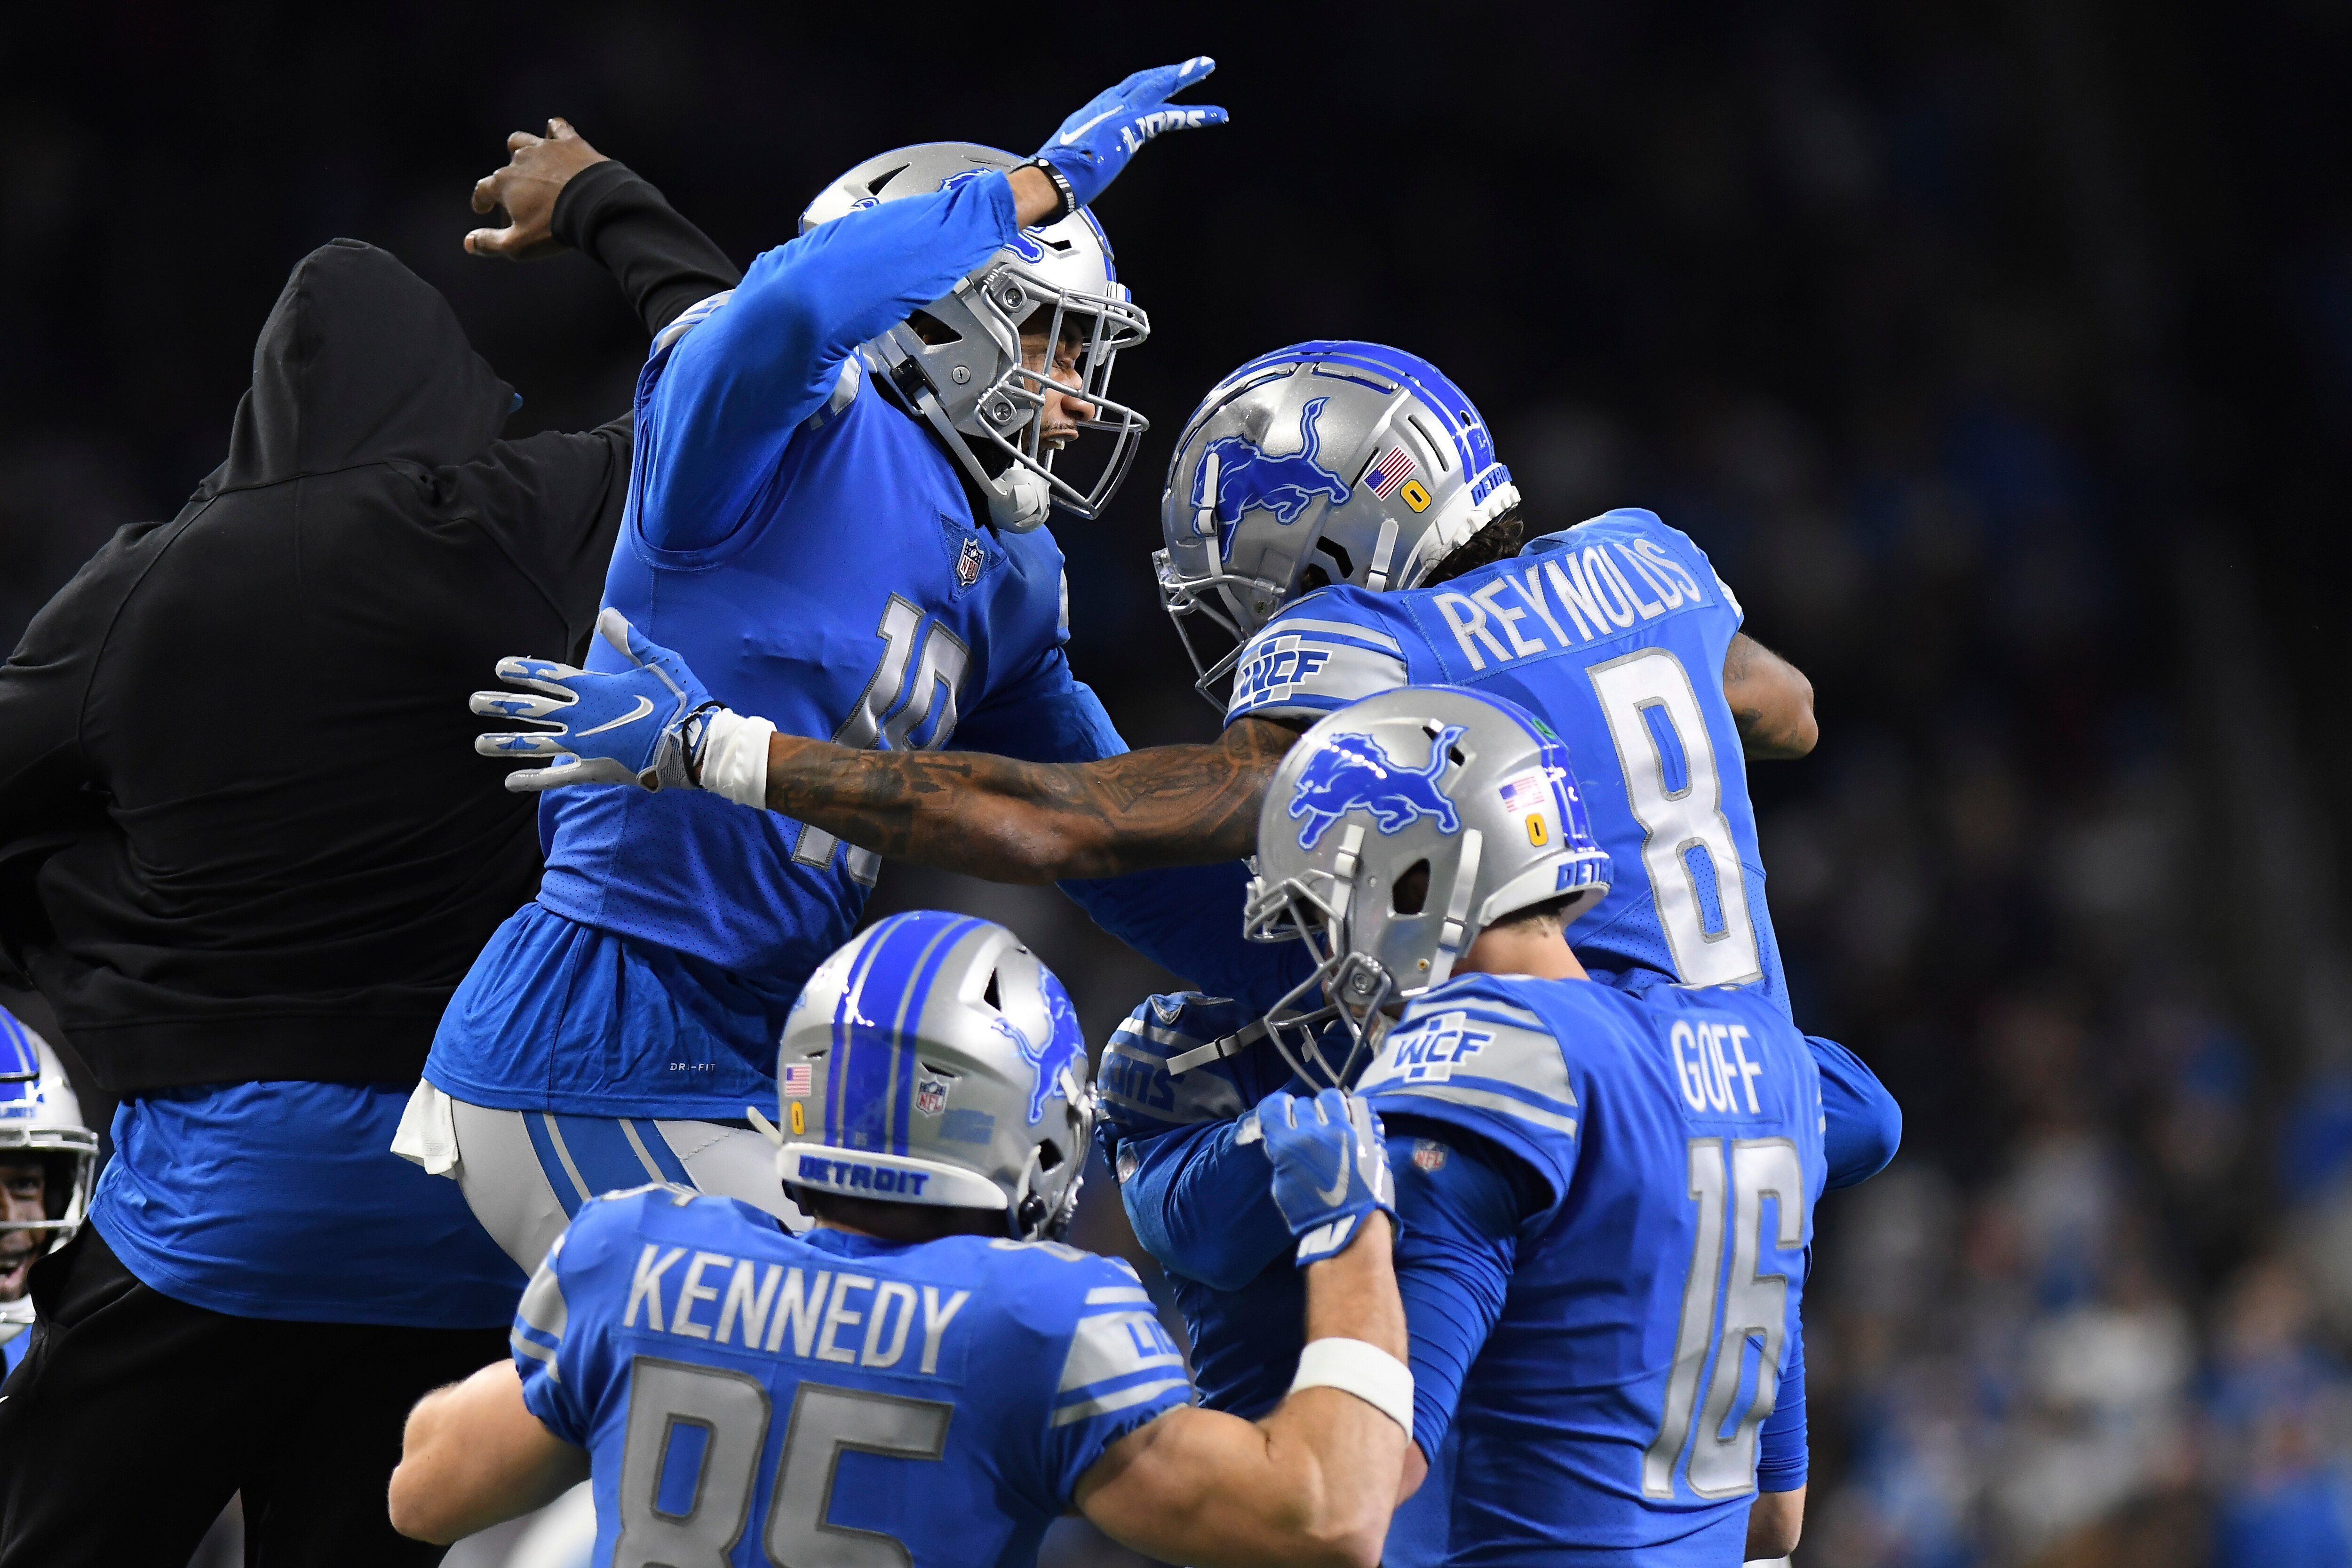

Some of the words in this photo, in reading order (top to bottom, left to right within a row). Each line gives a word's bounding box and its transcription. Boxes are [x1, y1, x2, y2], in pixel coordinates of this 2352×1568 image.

[1432, 538, 1701, 671] REYNOLDS
[1585, 647, 1763, 986] 8
[1390, 1028, 1496, 1072] WCF
[1670, 1020, 1763, 1114] GOFF
[798, 1154, 930, 1195] DETROIT
[623, 1244, 971, 1374] KENNEDY
[1642, 1137, 1804, 1500] 16
[612, 1355, 954, 1568] 85
